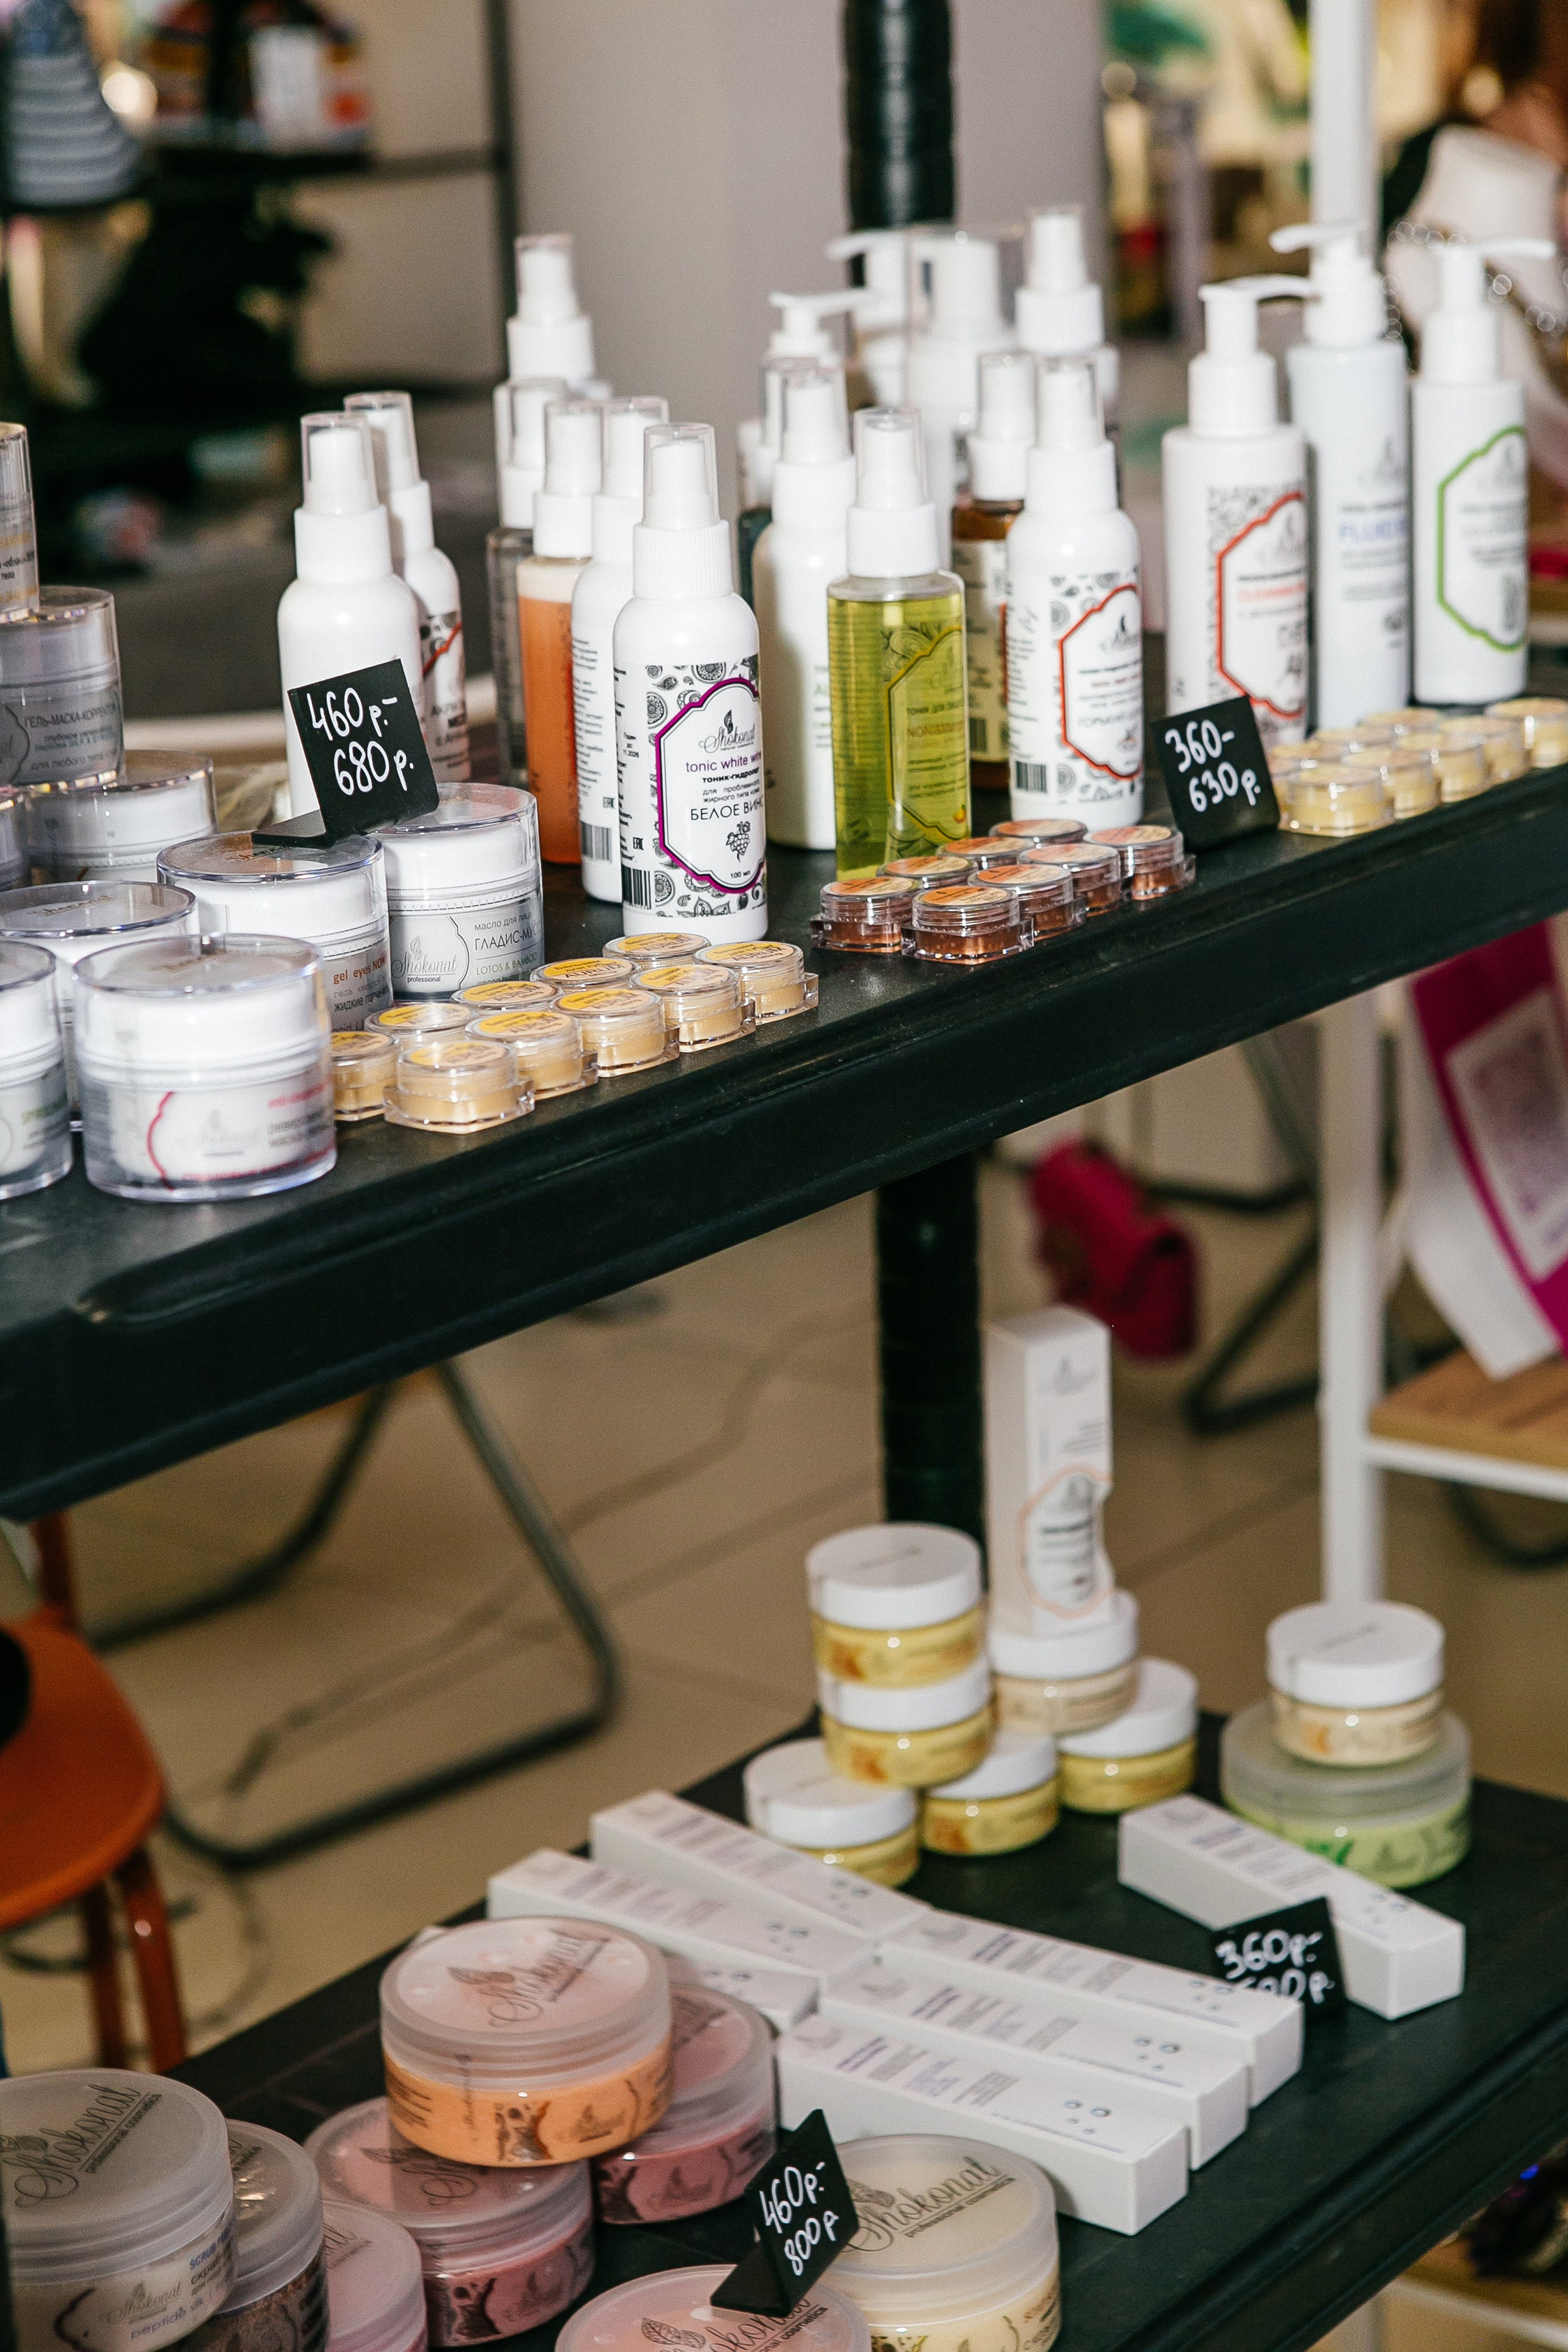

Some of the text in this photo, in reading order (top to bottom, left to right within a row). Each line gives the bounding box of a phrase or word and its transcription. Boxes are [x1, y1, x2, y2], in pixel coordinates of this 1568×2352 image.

[1165, 719, 1235, 773] 360-
[686, 761, 717, 772] tonic
[721, 756, 748, 769] white
[703, 794, 735, 804] жирного
[691, 804, 740, 821] БЕЛОЕ
[475, 921, 502, 931] масло
[503, 916, 517, 927] для
[333, 969, 348, 985] gel
[353, 965, 371, 979] eyes
[477, 963, 503, 975] LOTOS
[781, 2307, 829, 2340] cosmetics
